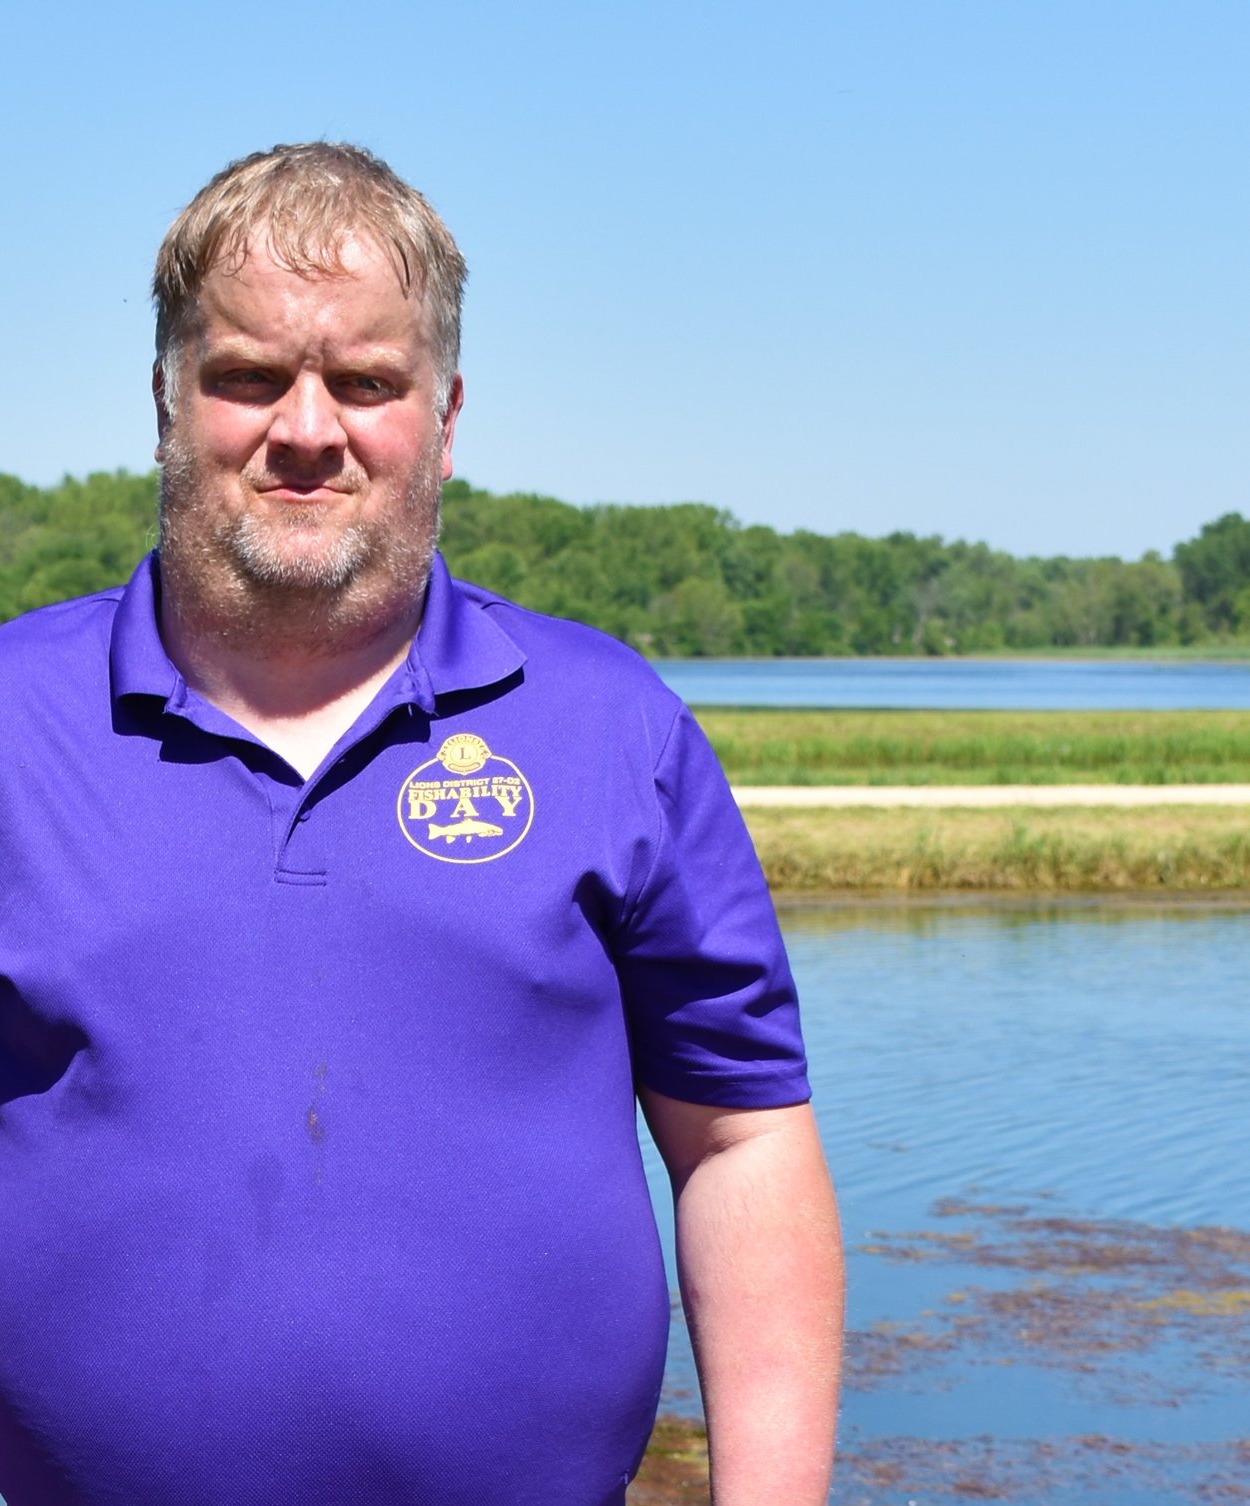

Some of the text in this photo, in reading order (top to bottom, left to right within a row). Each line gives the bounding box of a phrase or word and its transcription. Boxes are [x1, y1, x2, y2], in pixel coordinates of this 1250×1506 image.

[460, 747, 471, 760] L
[409, 781, 441, 789] LIONS
[442, 778, 490, 788] DISTRICT
[408, 784, 522, 801] FISHABILITY
[408, 797, 523, 820] DAY
